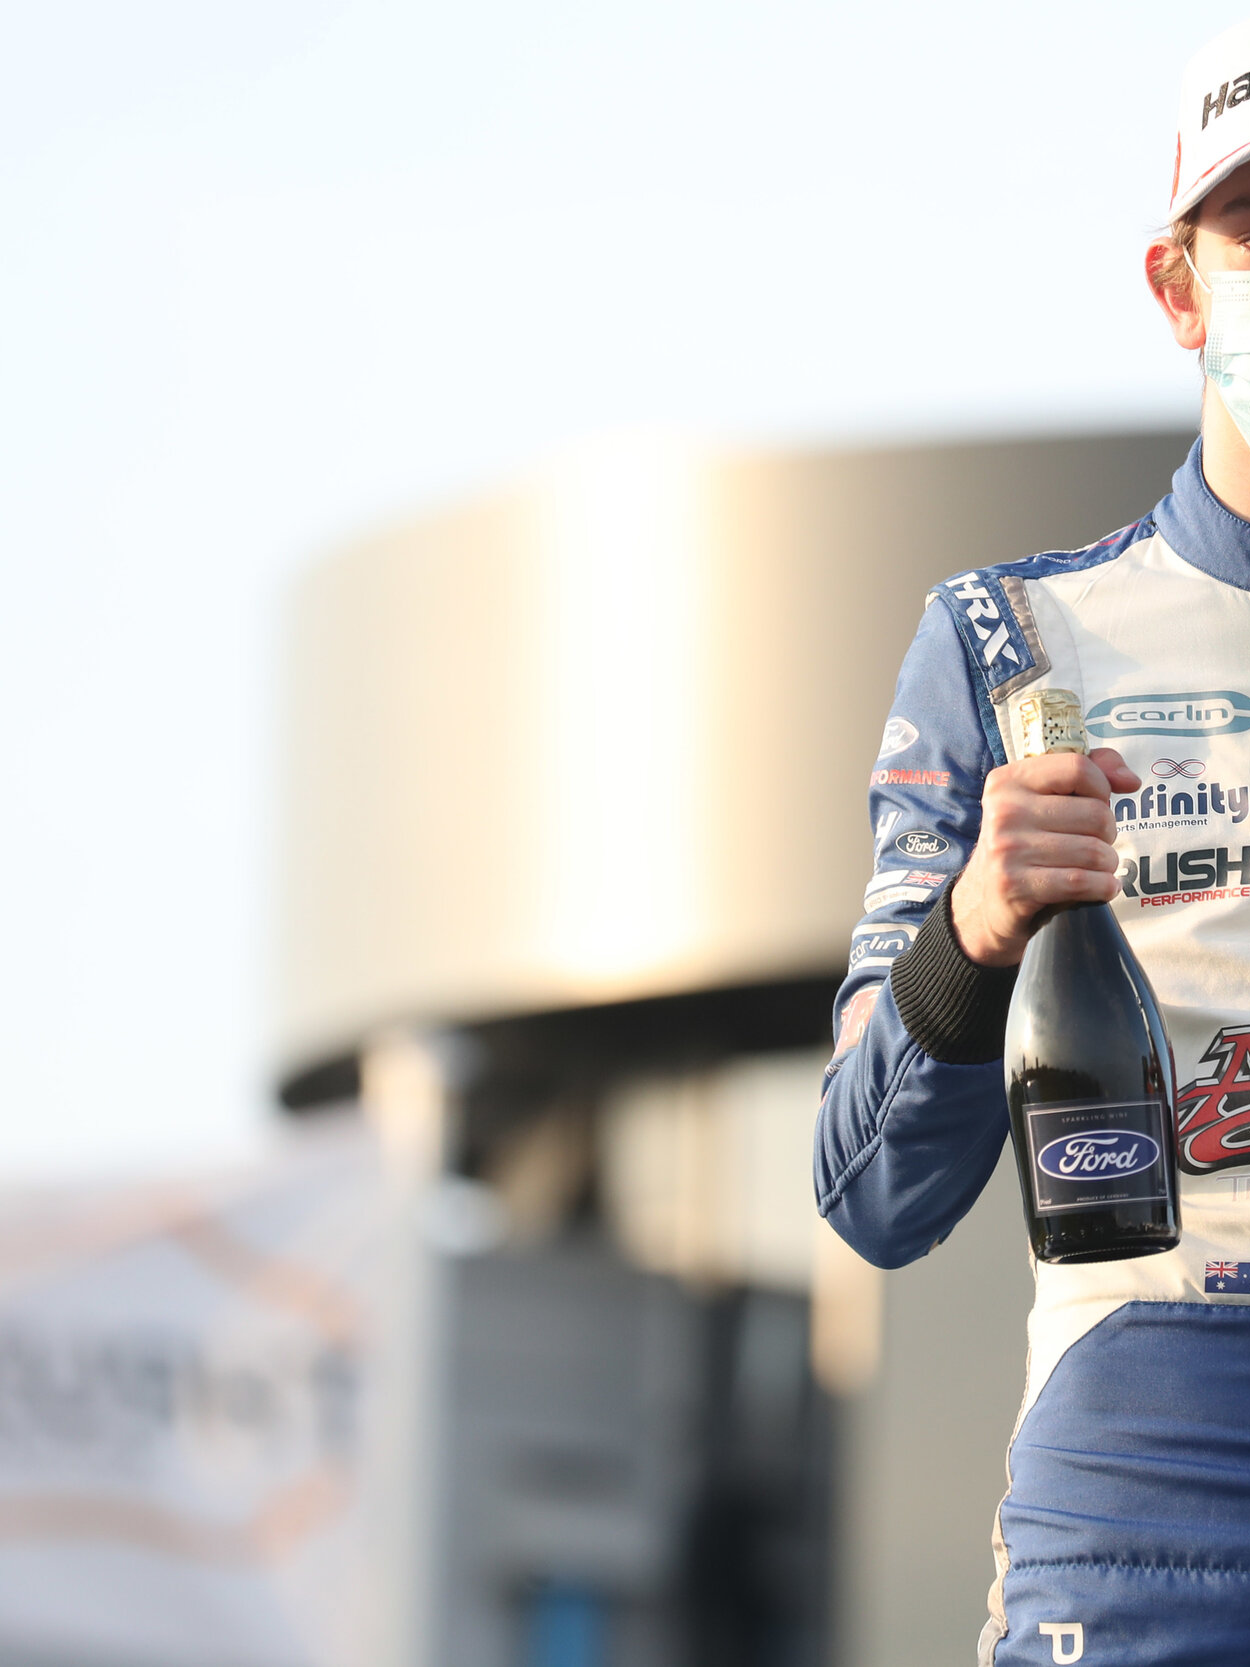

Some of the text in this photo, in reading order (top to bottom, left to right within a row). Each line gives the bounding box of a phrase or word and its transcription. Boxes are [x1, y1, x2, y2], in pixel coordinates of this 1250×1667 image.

[945, 572, 1020, 667] HRX
[1116, 704, 1229, 722] carlin
[1108, 782, 1250, 824] nfinity
[1116, 818, 1208, 833] orts Management
[905, 834, 940, 853] Ford
[1058, 1136, 1139, 1174] Ford
